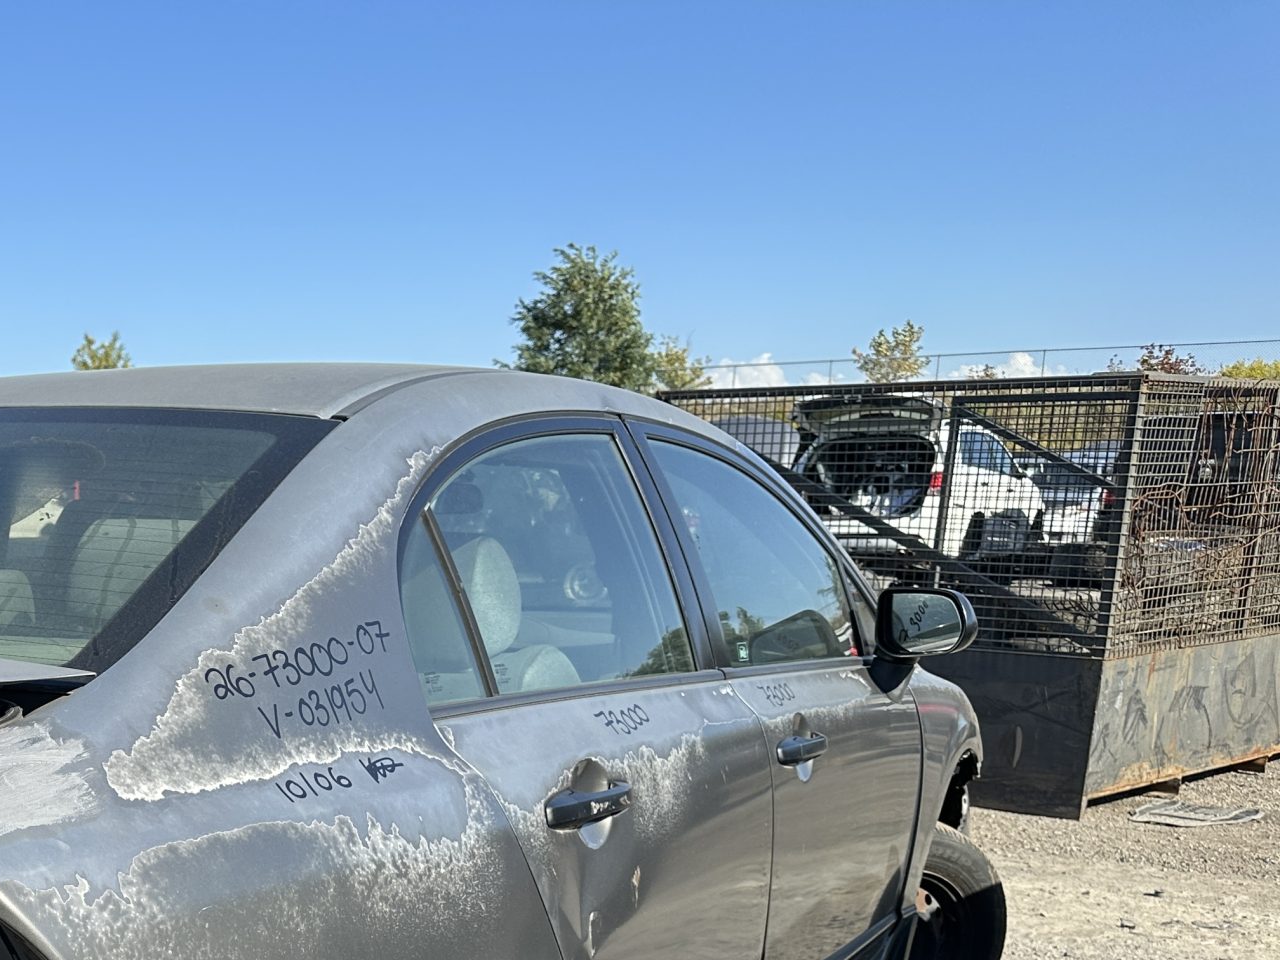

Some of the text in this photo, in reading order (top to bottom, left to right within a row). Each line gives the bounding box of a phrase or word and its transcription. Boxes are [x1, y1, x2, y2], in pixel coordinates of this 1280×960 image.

[204, 620, 390, 700] 26-73000-07
[257, 668, 384, 739] V-031954
[593, 703, 650, 735] 73000
[756, 682, 795, 708] 73000
